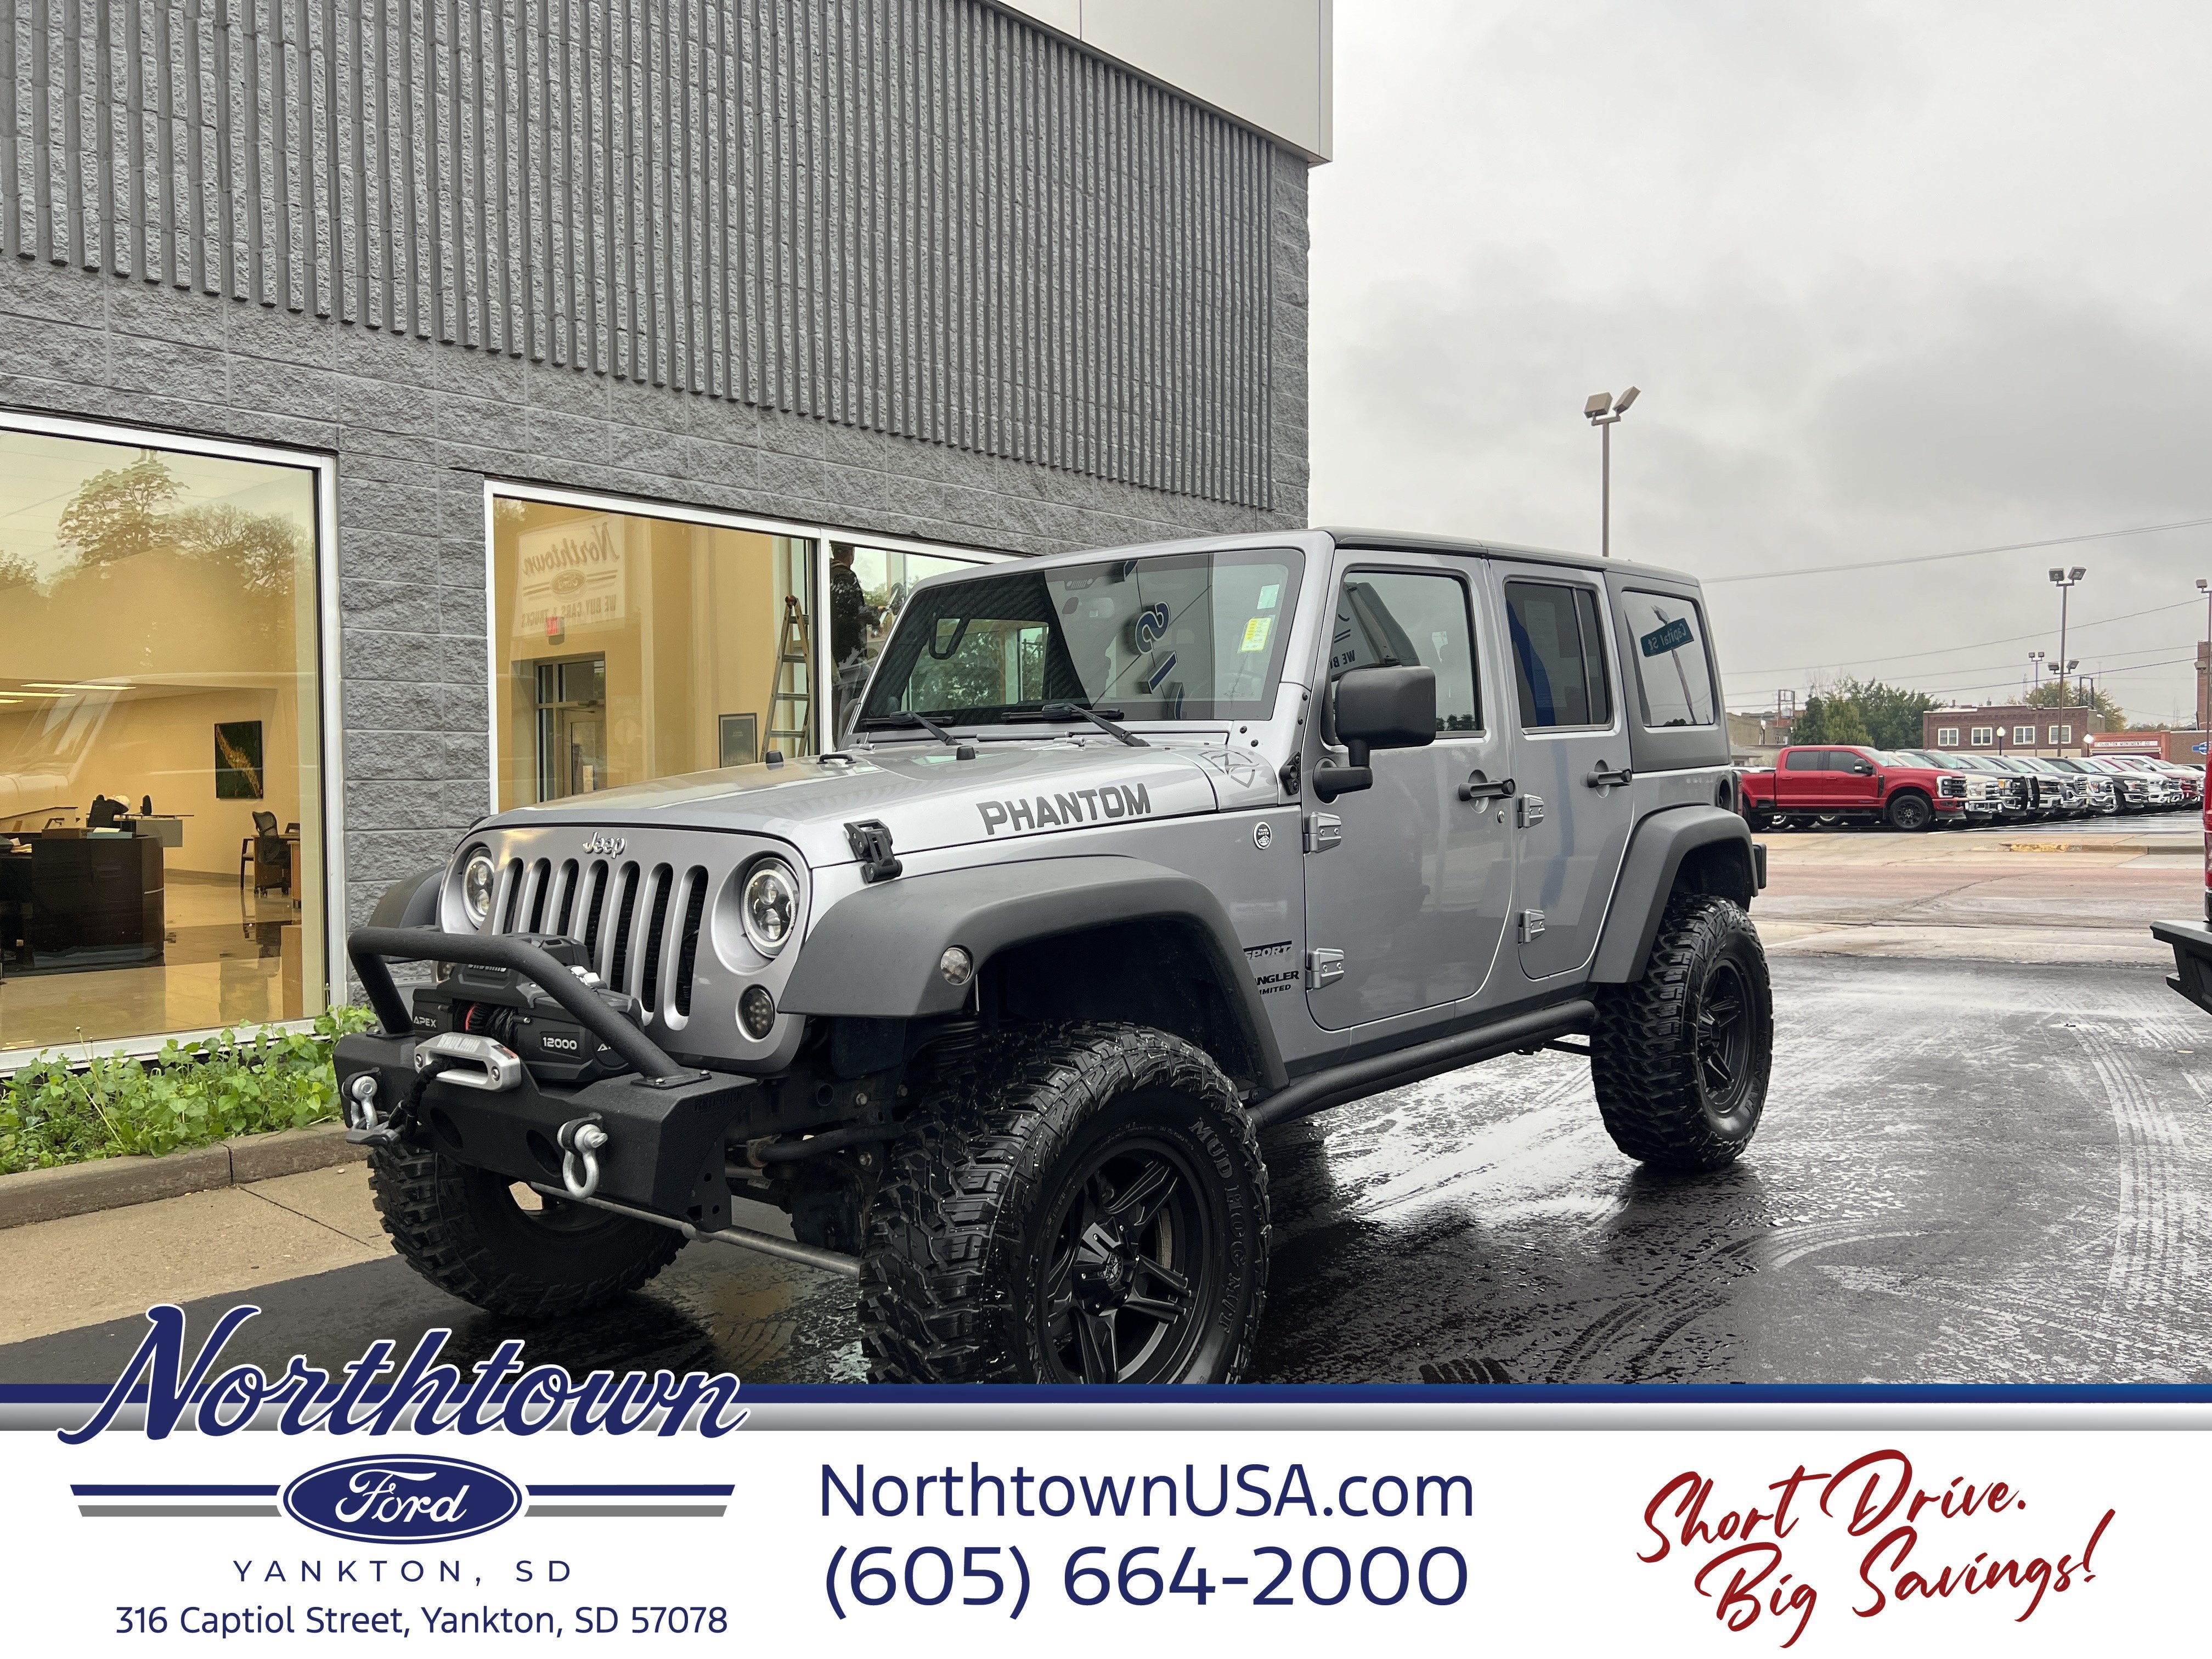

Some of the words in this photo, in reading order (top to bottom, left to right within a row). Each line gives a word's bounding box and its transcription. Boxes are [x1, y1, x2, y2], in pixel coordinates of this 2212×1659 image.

[976, 783, 1151, 836] PHANTOM
[582, 831, 625, 859] Jeep
[413, 1015, 437, 1028] APEX
[543, 1036, 578, 1051] 12000
[1189, 1117, 1234, 1178] MUD
[1224, 1184, 1247, 1267] HOG
